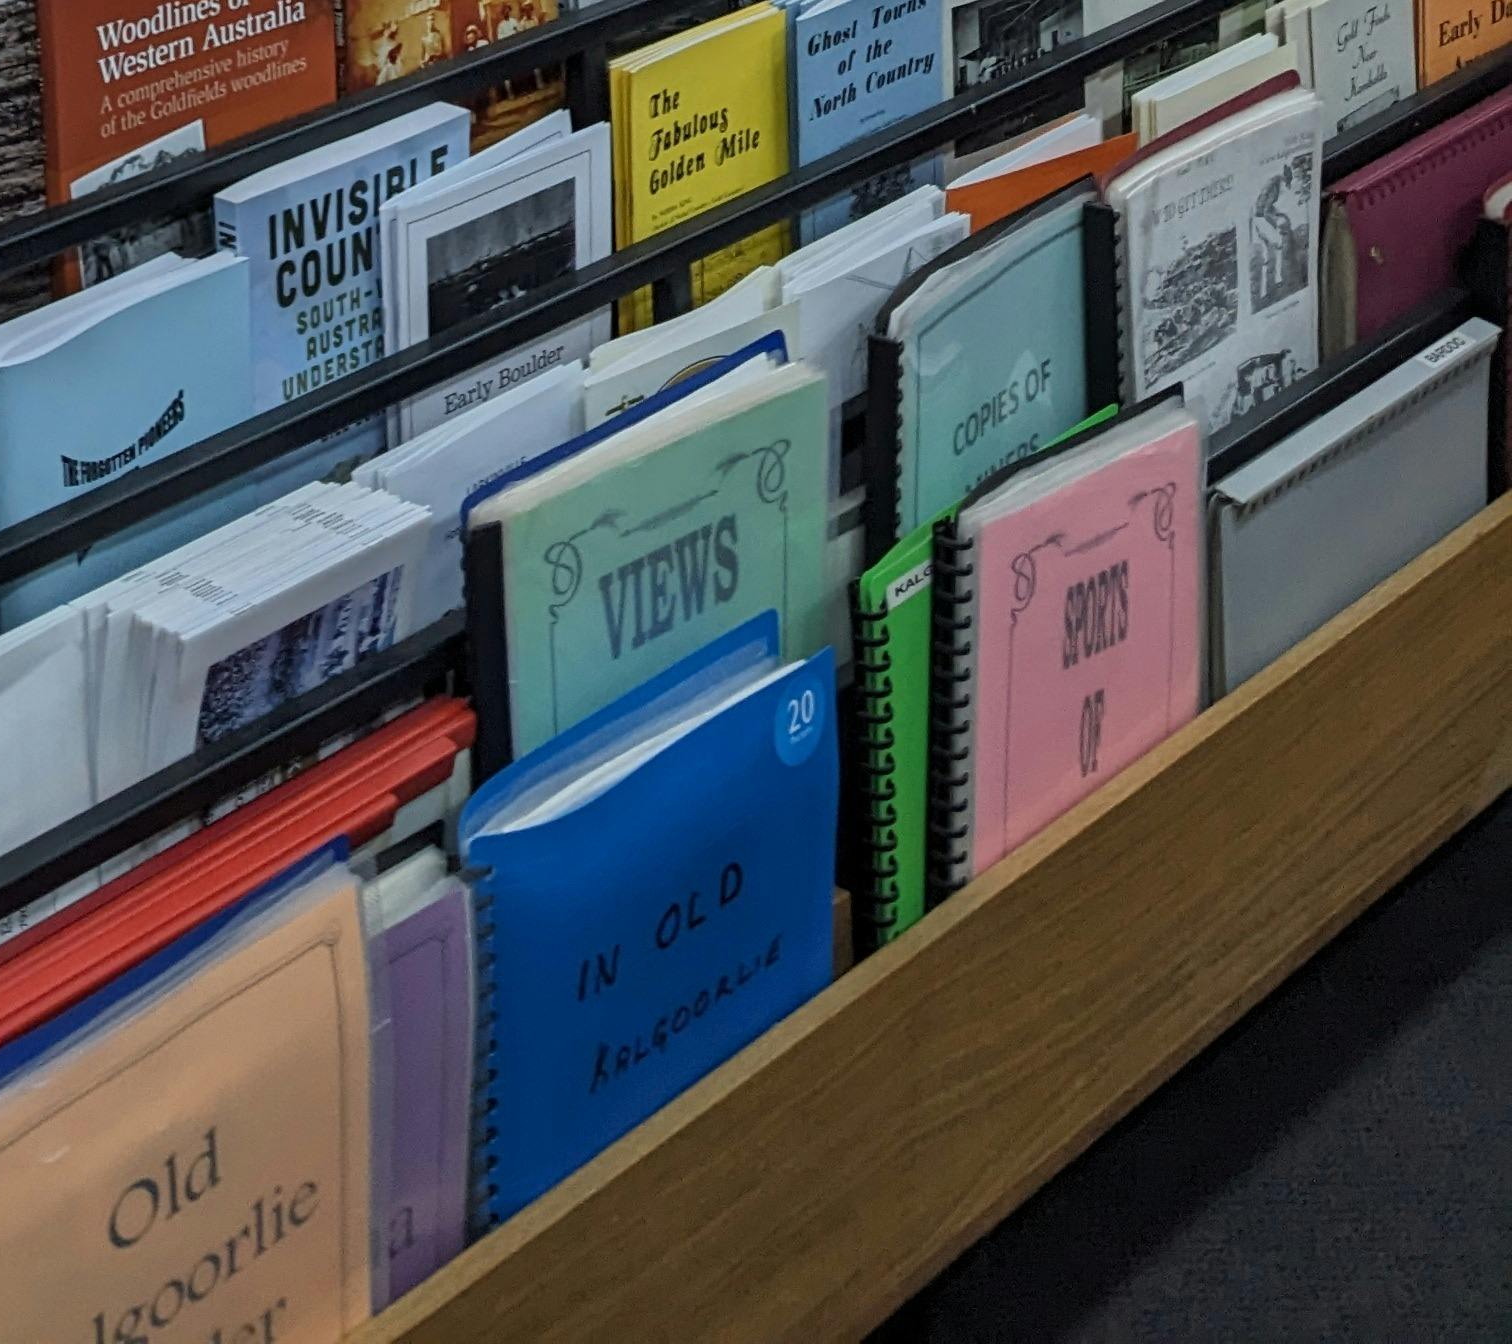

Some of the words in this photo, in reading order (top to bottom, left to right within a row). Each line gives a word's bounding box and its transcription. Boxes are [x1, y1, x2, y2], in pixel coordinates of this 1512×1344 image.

[97, 37, 196, 85] Western
[101, 117, 116, 139] of
[119, 108, 147, 132] the
[150, 79, 227, 123] Goldfields
[230, 54, 308, 95] woodlines
[837, 54, 854, 77] of
[865, 34, 893, 63] the
[648, 87, 681, 120] The
[951, 379, 1022, 459] COPIES
[1026, 358, 1052, 400] OF
[61, 454, 79, 487] THE
[81, 443, 136, 484] FORGOTTEN
[597, 511, 741, 662] VIEWS
[1061, 560, 1130, 671] SPORTS
[786, 688, 815, 736] 20
[578, 942, 621, 1002] IN
[654, 861, 744, 951] OLD
[590, 934, 783, 1094] KALGOORLIE
[107, 1122, 226, 1257] Old
